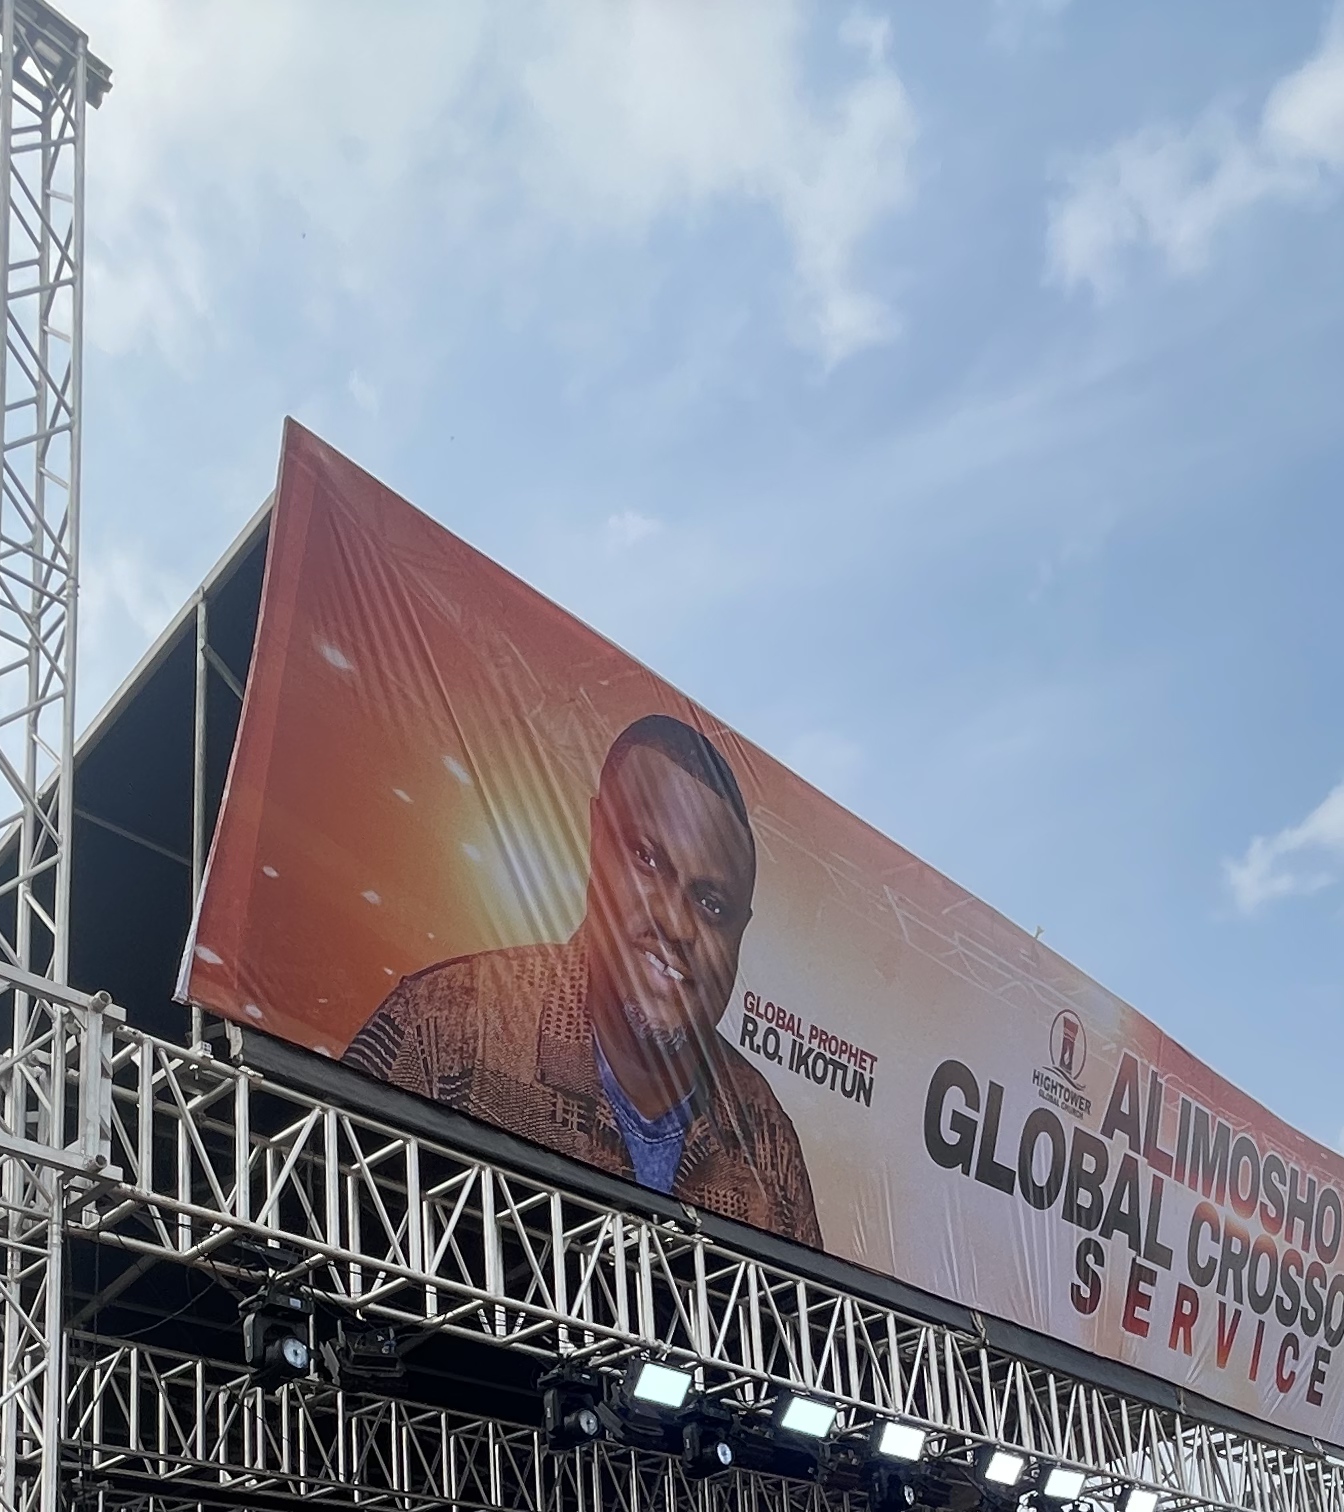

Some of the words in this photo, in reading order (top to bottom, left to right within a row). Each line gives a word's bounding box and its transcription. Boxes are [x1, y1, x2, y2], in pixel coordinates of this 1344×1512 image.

[739, 1013, 783, 1066] R.O.
[788, 1038, 874, 1108] IKOTUN
[744, 991, 805, 1040] GLOBAL
[808, 1024, 878, 1075] PROPHET
[1032, 1069, 1092, 1115] HIGHTOWER
[923, 1059, 1174, 1271] GLOBAL
[1100, 1052, 1343, 1264] ALIMOSHO
[1070, 1238, 1332, 1407] SERVICE
